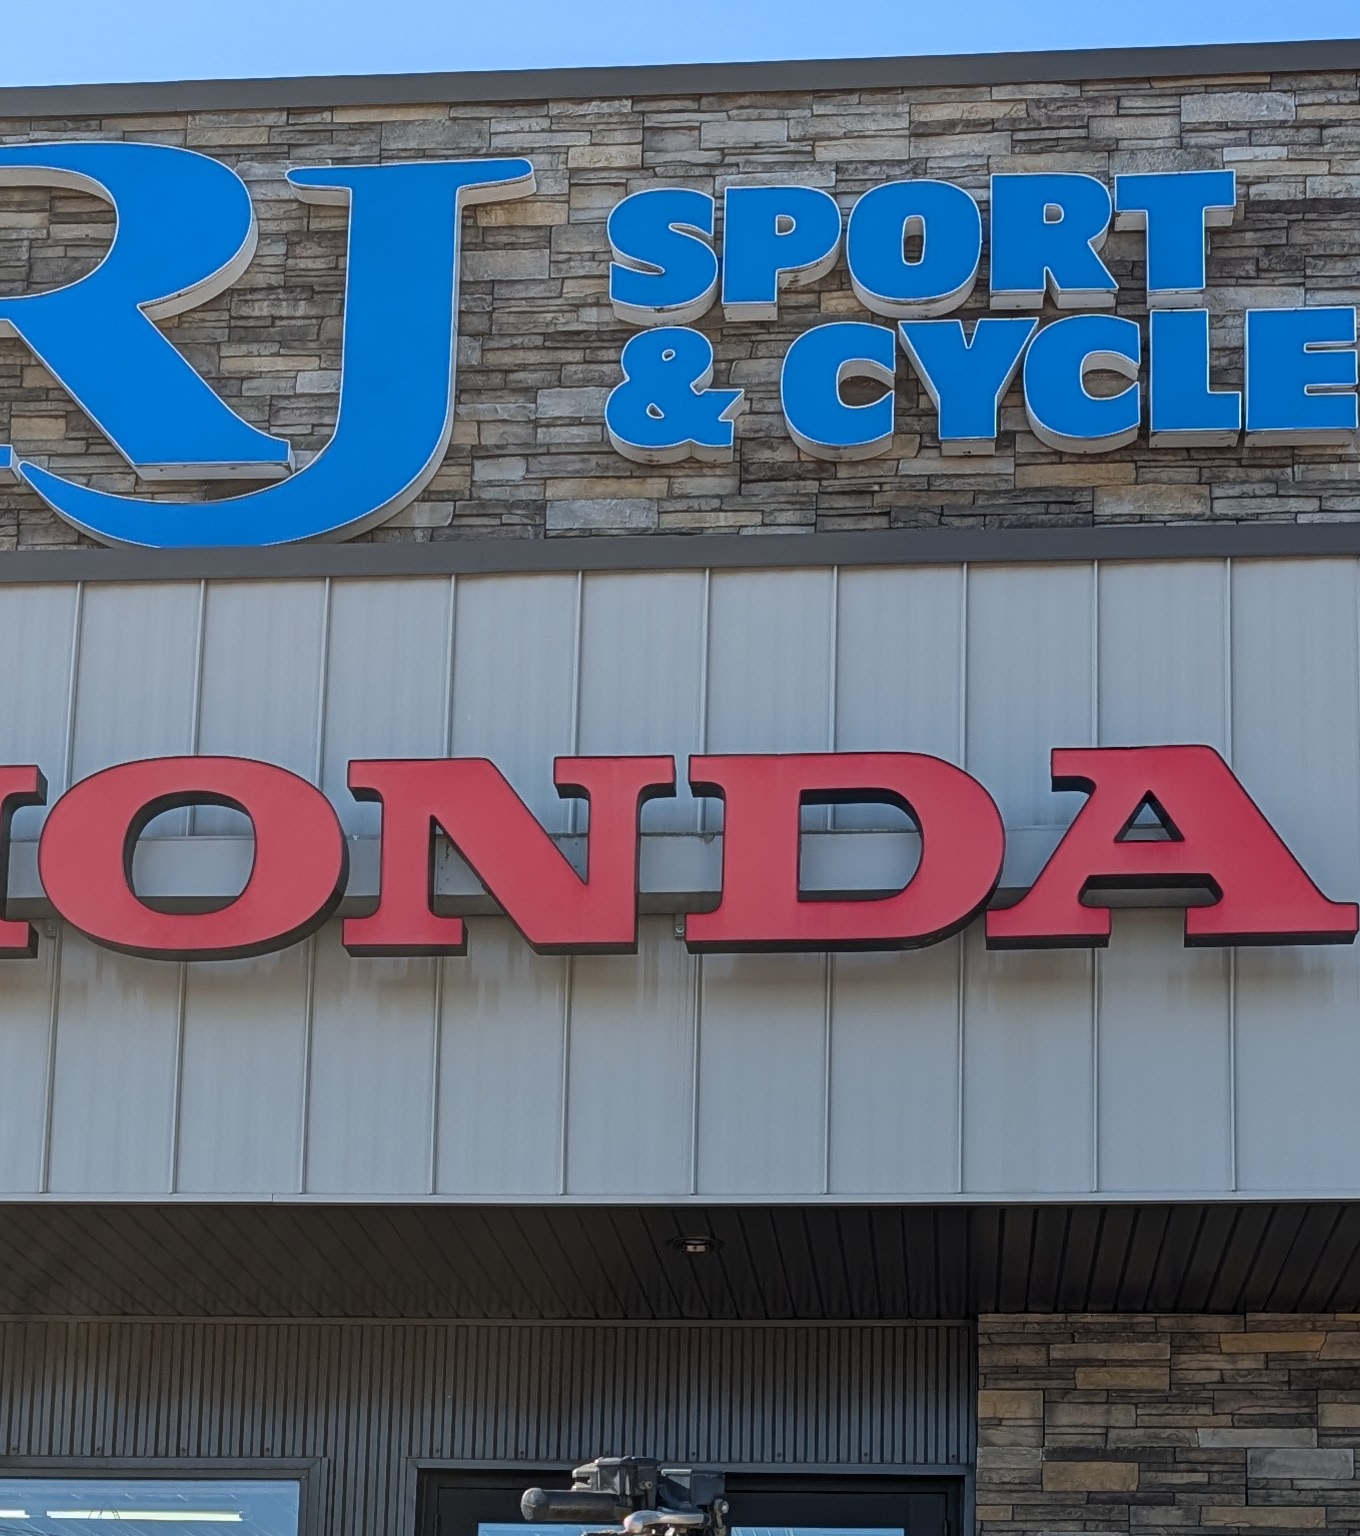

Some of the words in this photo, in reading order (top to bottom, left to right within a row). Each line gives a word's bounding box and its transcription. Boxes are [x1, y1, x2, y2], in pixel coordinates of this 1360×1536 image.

[606, 169, 1238, 322] SPORT
[606, 327, 744, 463] &
[781, 305, 1359, 460] CYCLE
